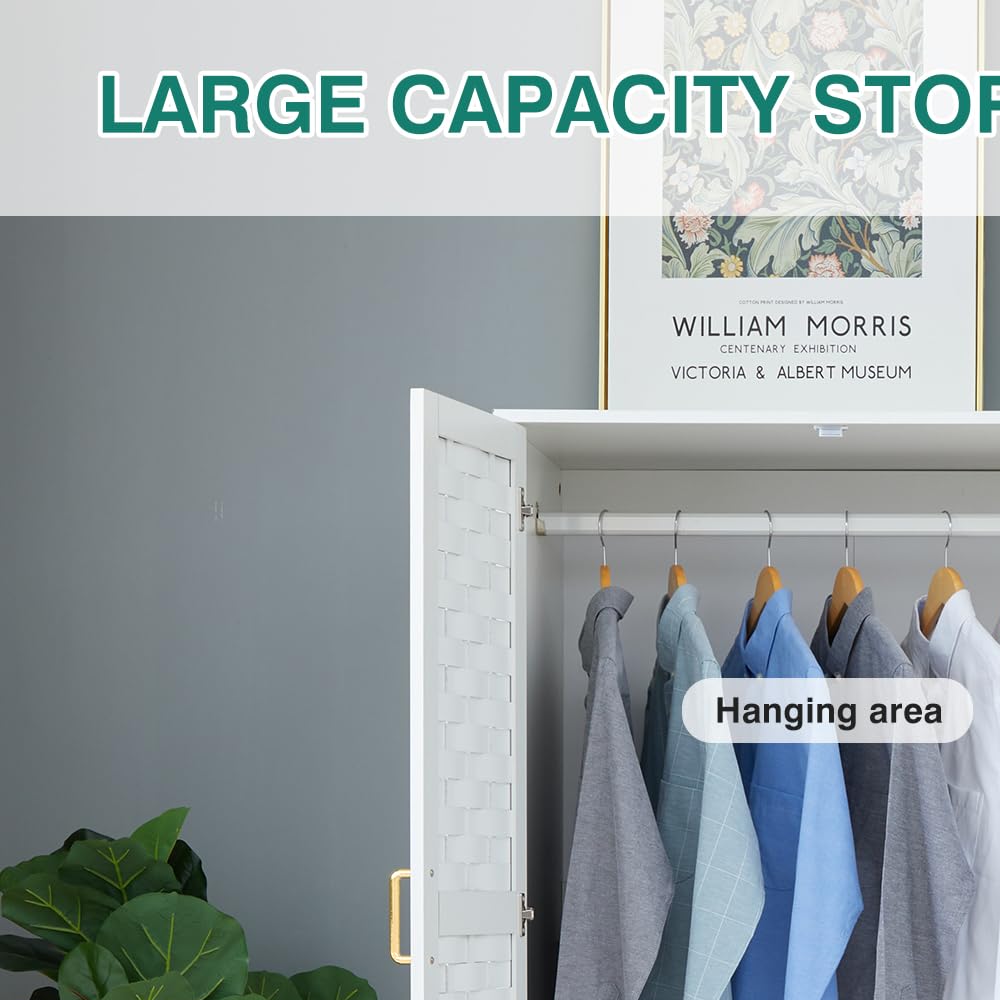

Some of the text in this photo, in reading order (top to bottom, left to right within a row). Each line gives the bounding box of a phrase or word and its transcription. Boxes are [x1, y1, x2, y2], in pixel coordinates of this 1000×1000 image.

[672, 315, 912, 337] WILLIAM MORRIS
[719, 344, 857, 354] CENTENARY EXHIBITION
[671, 365, 912, 379] VICTORIA & ALBERT MUSEUM
